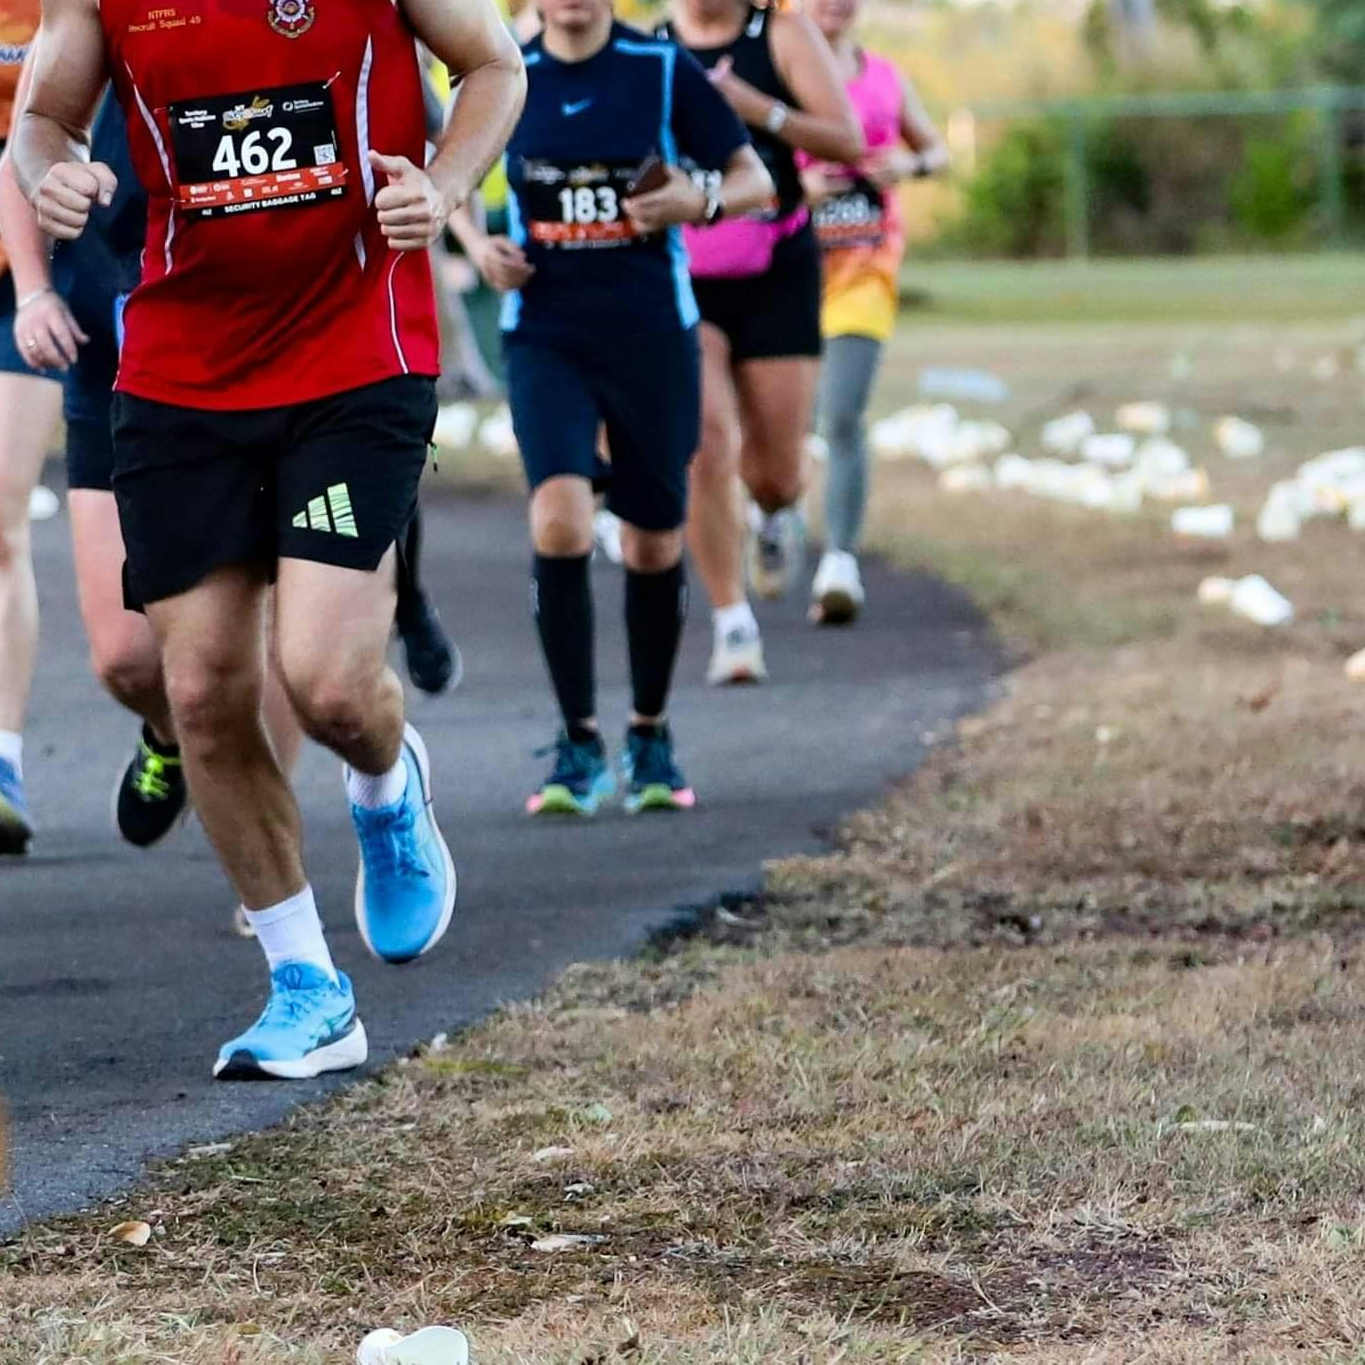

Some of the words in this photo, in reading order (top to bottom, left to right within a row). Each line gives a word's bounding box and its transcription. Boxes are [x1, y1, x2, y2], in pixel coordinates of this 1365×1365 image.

[212, 127, 297, 178] 462
[224, 200, 262, 213] SECURITY
[262, 195, 299, 208] BAGGAGE
[299, 191, 317, 203] TAG
[558, 186, 618, 223] 183
